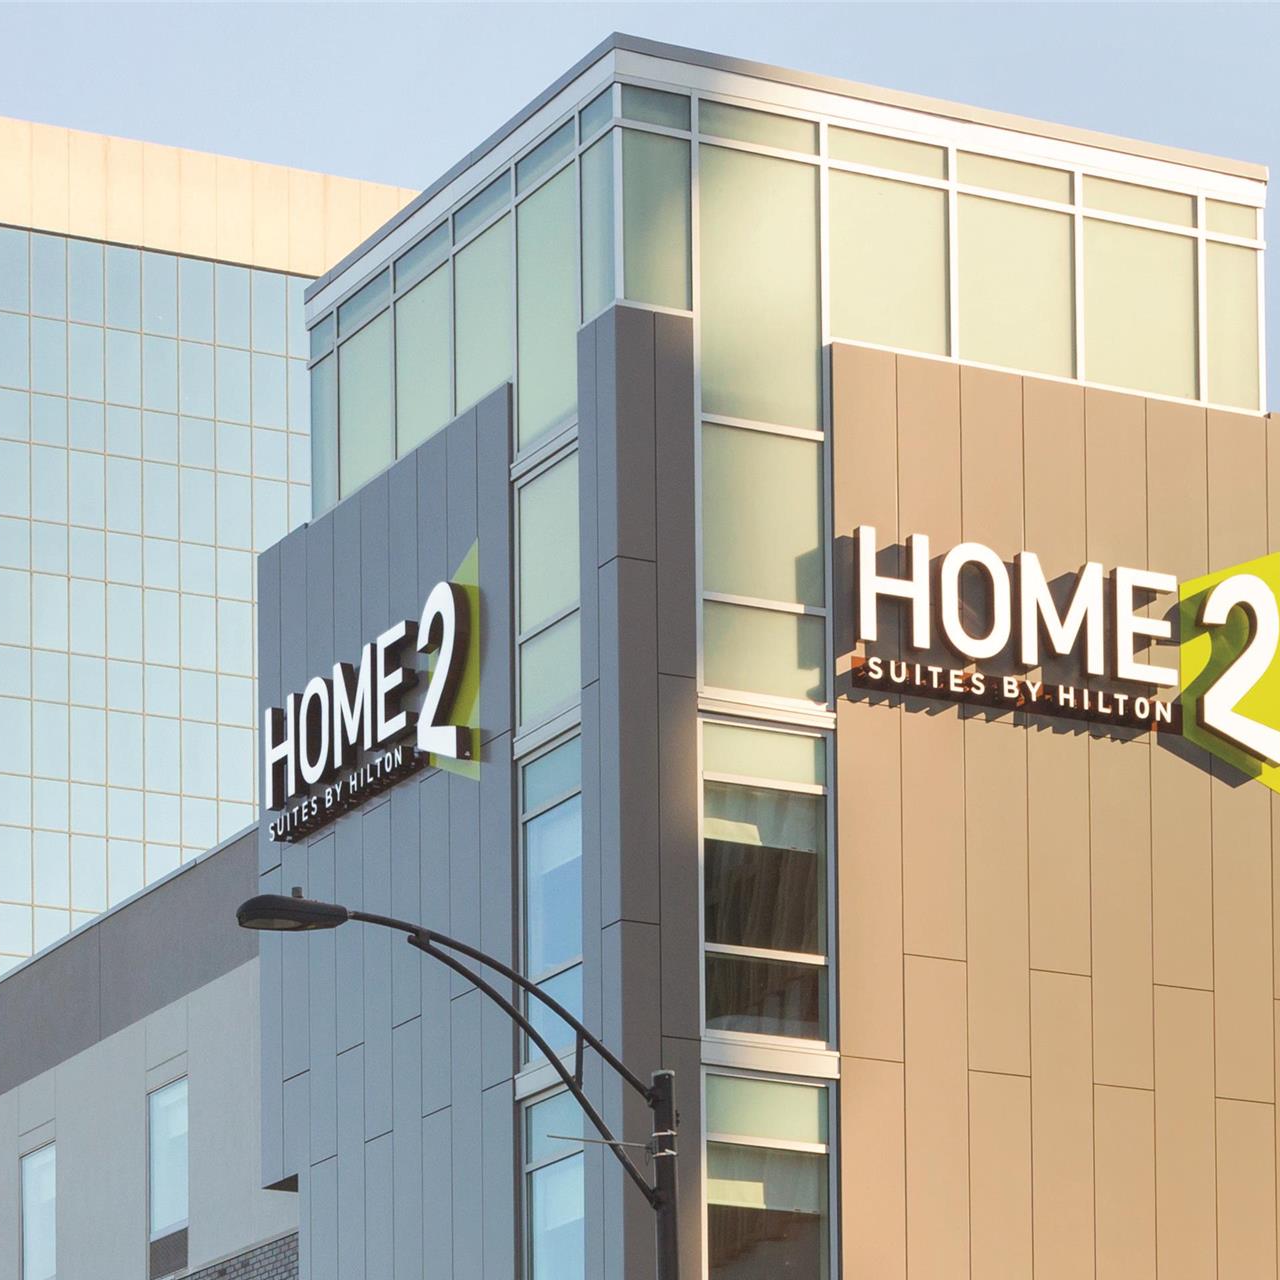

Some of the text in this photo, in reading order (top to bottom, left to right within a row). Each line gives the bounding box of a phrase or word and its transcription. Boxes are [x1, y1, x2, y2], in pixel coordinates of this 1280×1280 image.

[868, 656, 1173, 724] SUITES BY HILTON
[268, 745, 403, 842] SUITES BY HILTON
